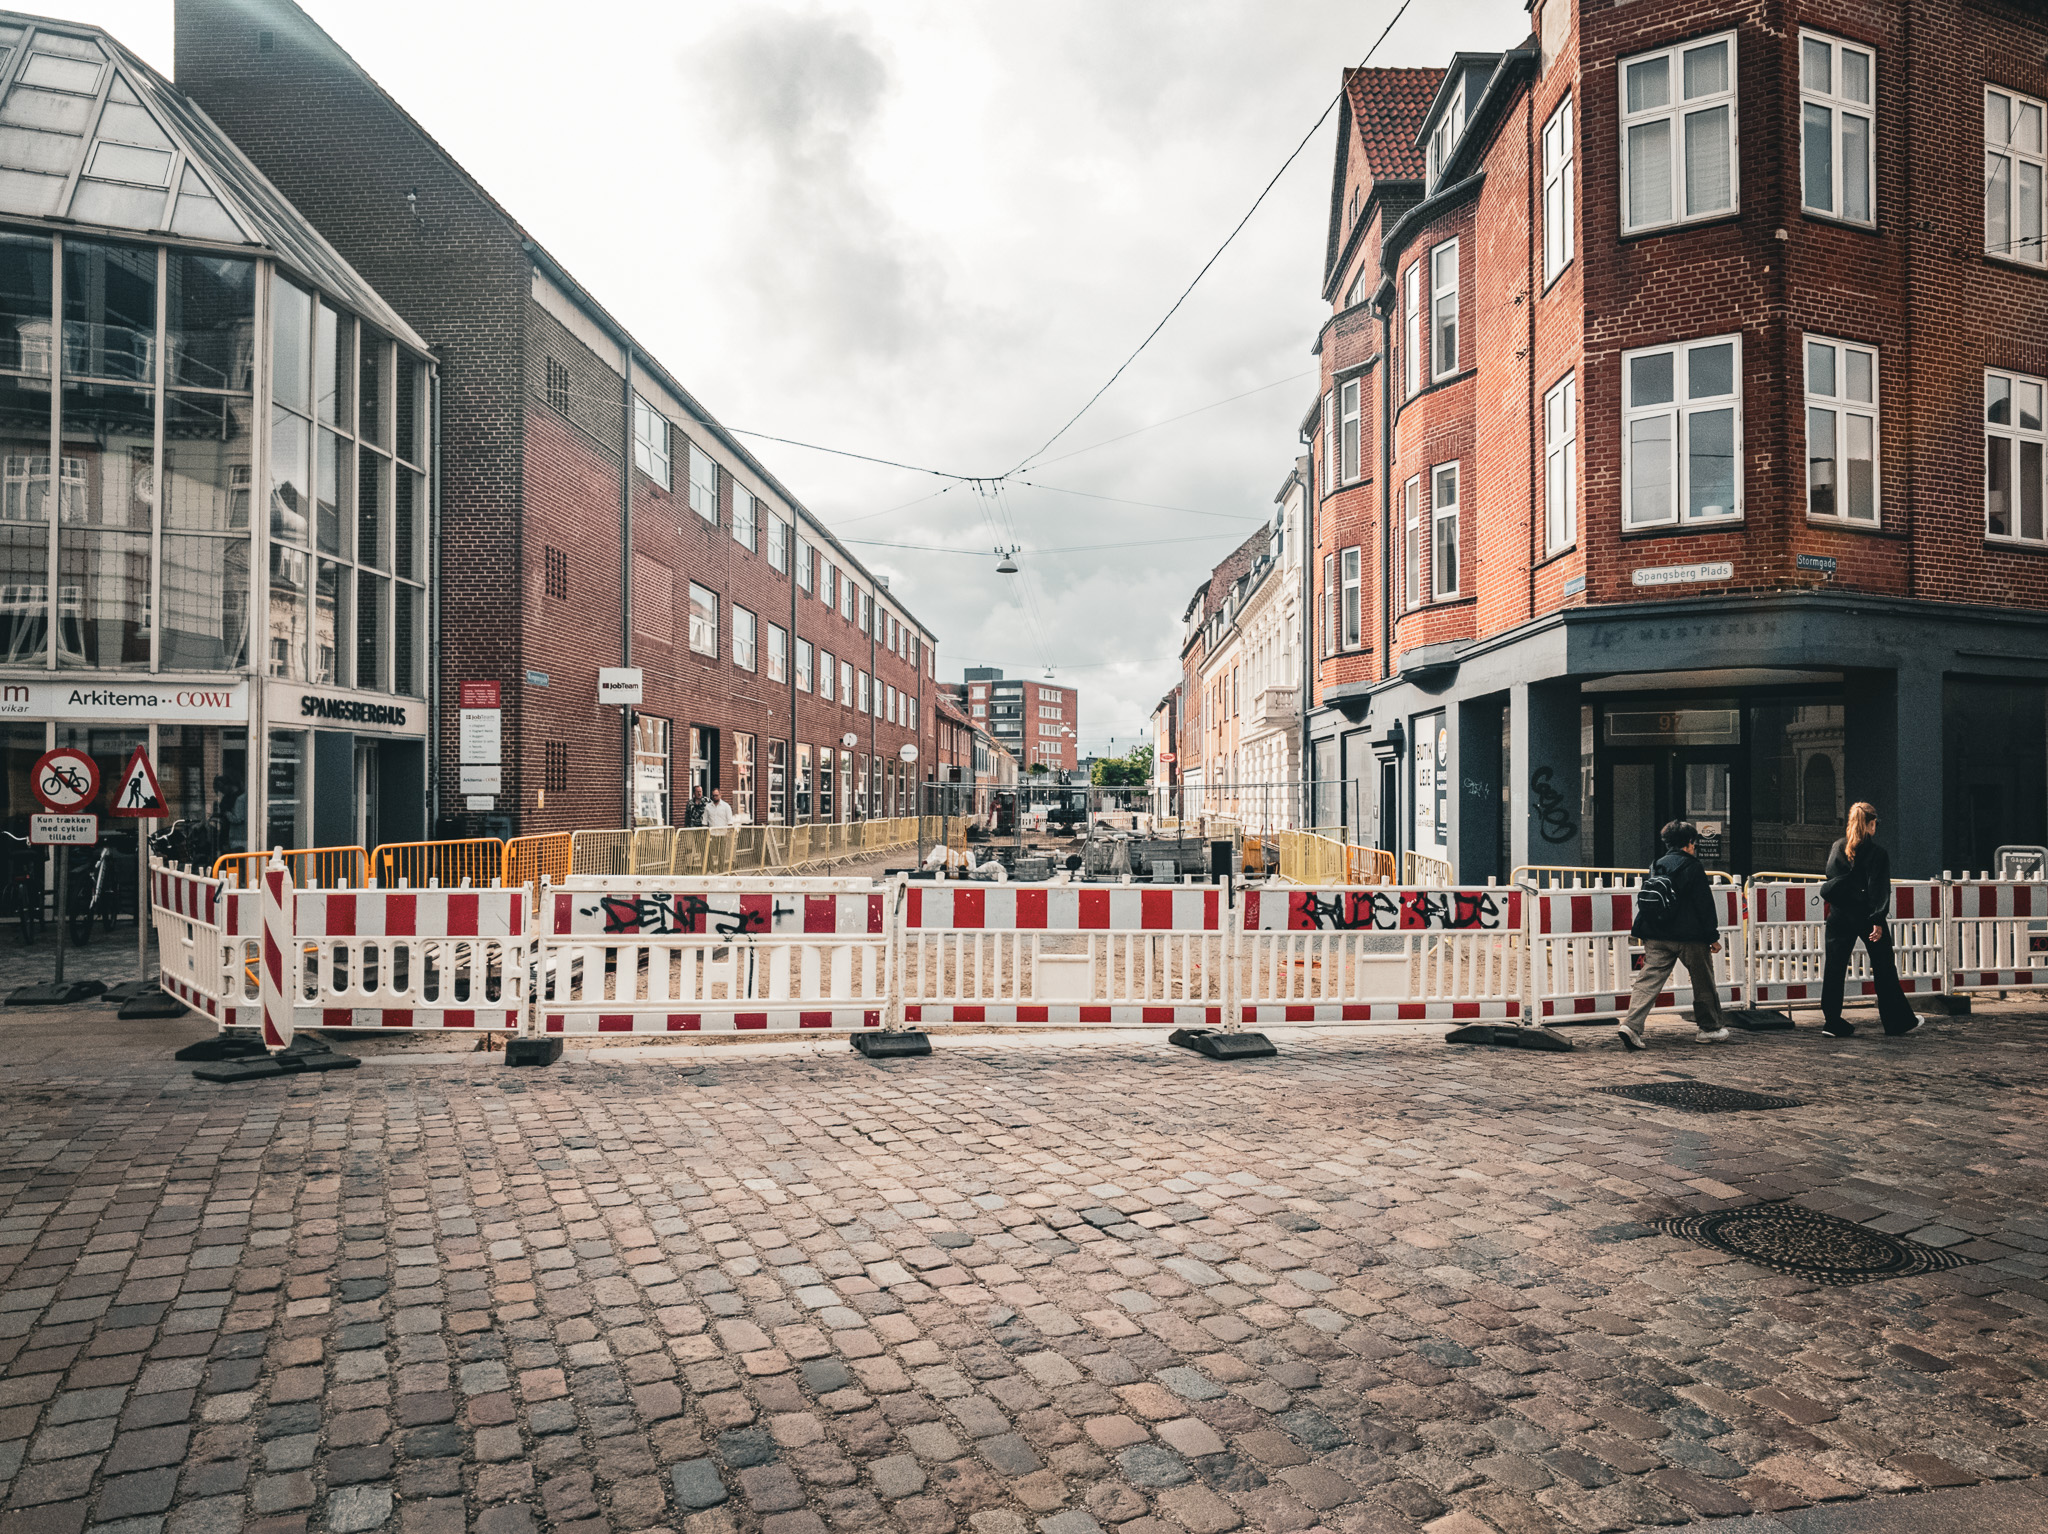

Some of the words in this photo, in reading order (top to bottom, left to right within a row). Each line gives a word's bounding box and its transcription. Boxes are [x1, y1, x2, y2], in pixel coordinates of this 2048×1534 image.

[1798, 555, 1836, 569] Stormgade
[1637, 569, 1696, 583] Spangsberg
[1701, 566, 1729, 576] Plads
[68, 690, 158, 707] Arkitema
[176, 691, 233, 708] COWI
[300, 695, 407, 727] SPANGSBERGHUS
[1417, 743, 1433, 761] BUTIK
[1420, 769, 1431, 787] LEJE
[37, 816, 53, 824] Kun
[56, 816, 92, 824] trækken
[61, 825, 88, 833] cykler
